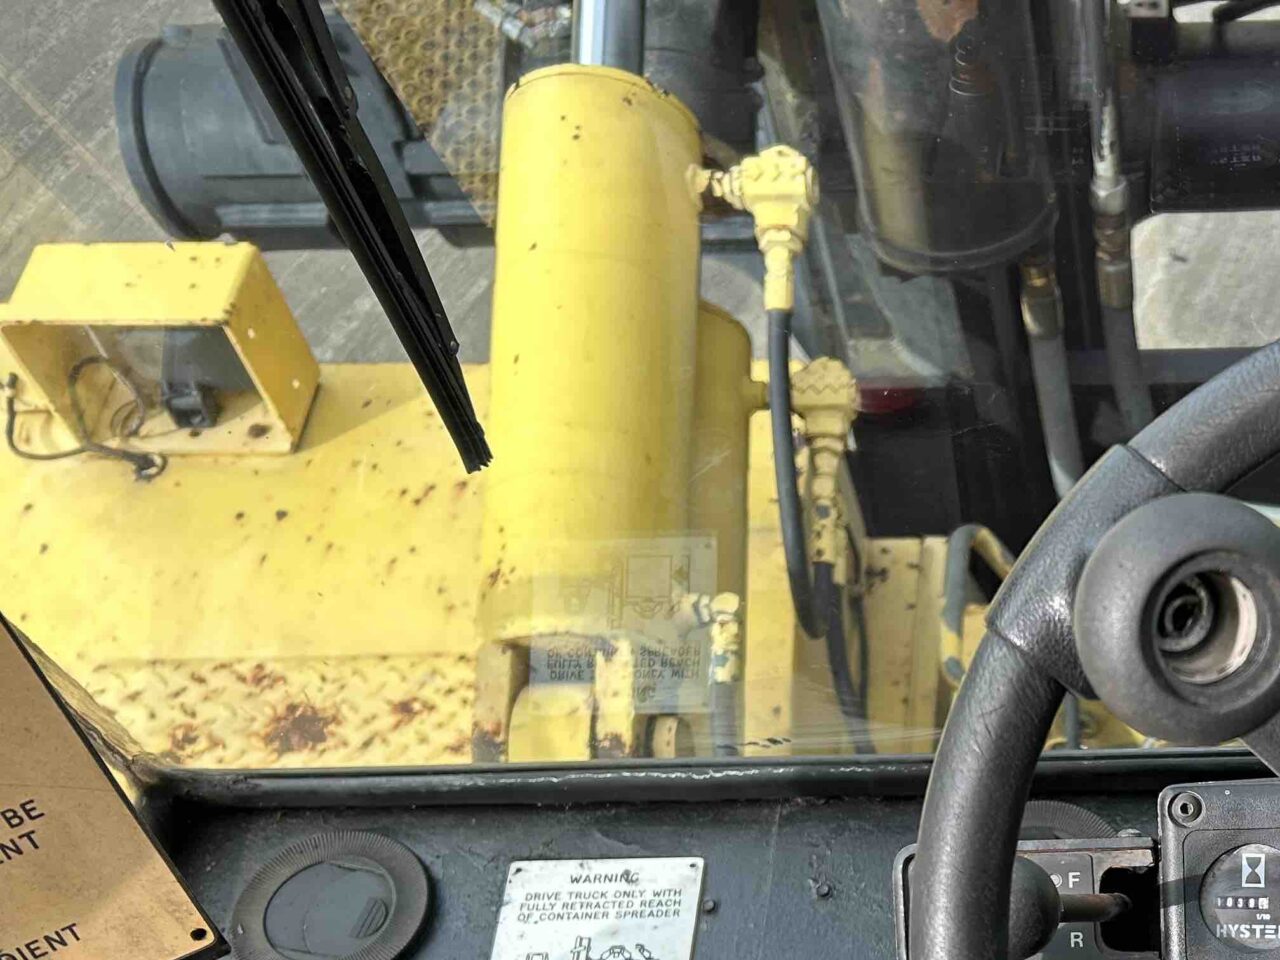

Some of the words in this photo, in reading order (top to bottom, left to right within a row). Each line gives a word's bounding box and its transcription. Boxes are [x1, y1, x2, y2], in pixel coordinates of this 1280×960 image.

[0, 799, 45, 829] BE
[0, 830, 39, 865] NT
[570, 872, 640, 884] WARNING
[1068, 872, 1080, 888] F
[525, 891, 561, 901] DRIVE
[568, 890, 608, 900] TRUCK
[613, 889, 647, 899] ONLY
[652, 888, 682, 898] WITH
[519, 902, 557, 911] FULLY
[561, 900, 634, 910] RETRACTED
[639, 899, 682, 908] REACH
[517, 912, 534, 922] OF
[539, 910, 609, 921] CONTAINER
[614, 909, 681, 919] SPREADER
[1070, 931, 1083, 948] R
